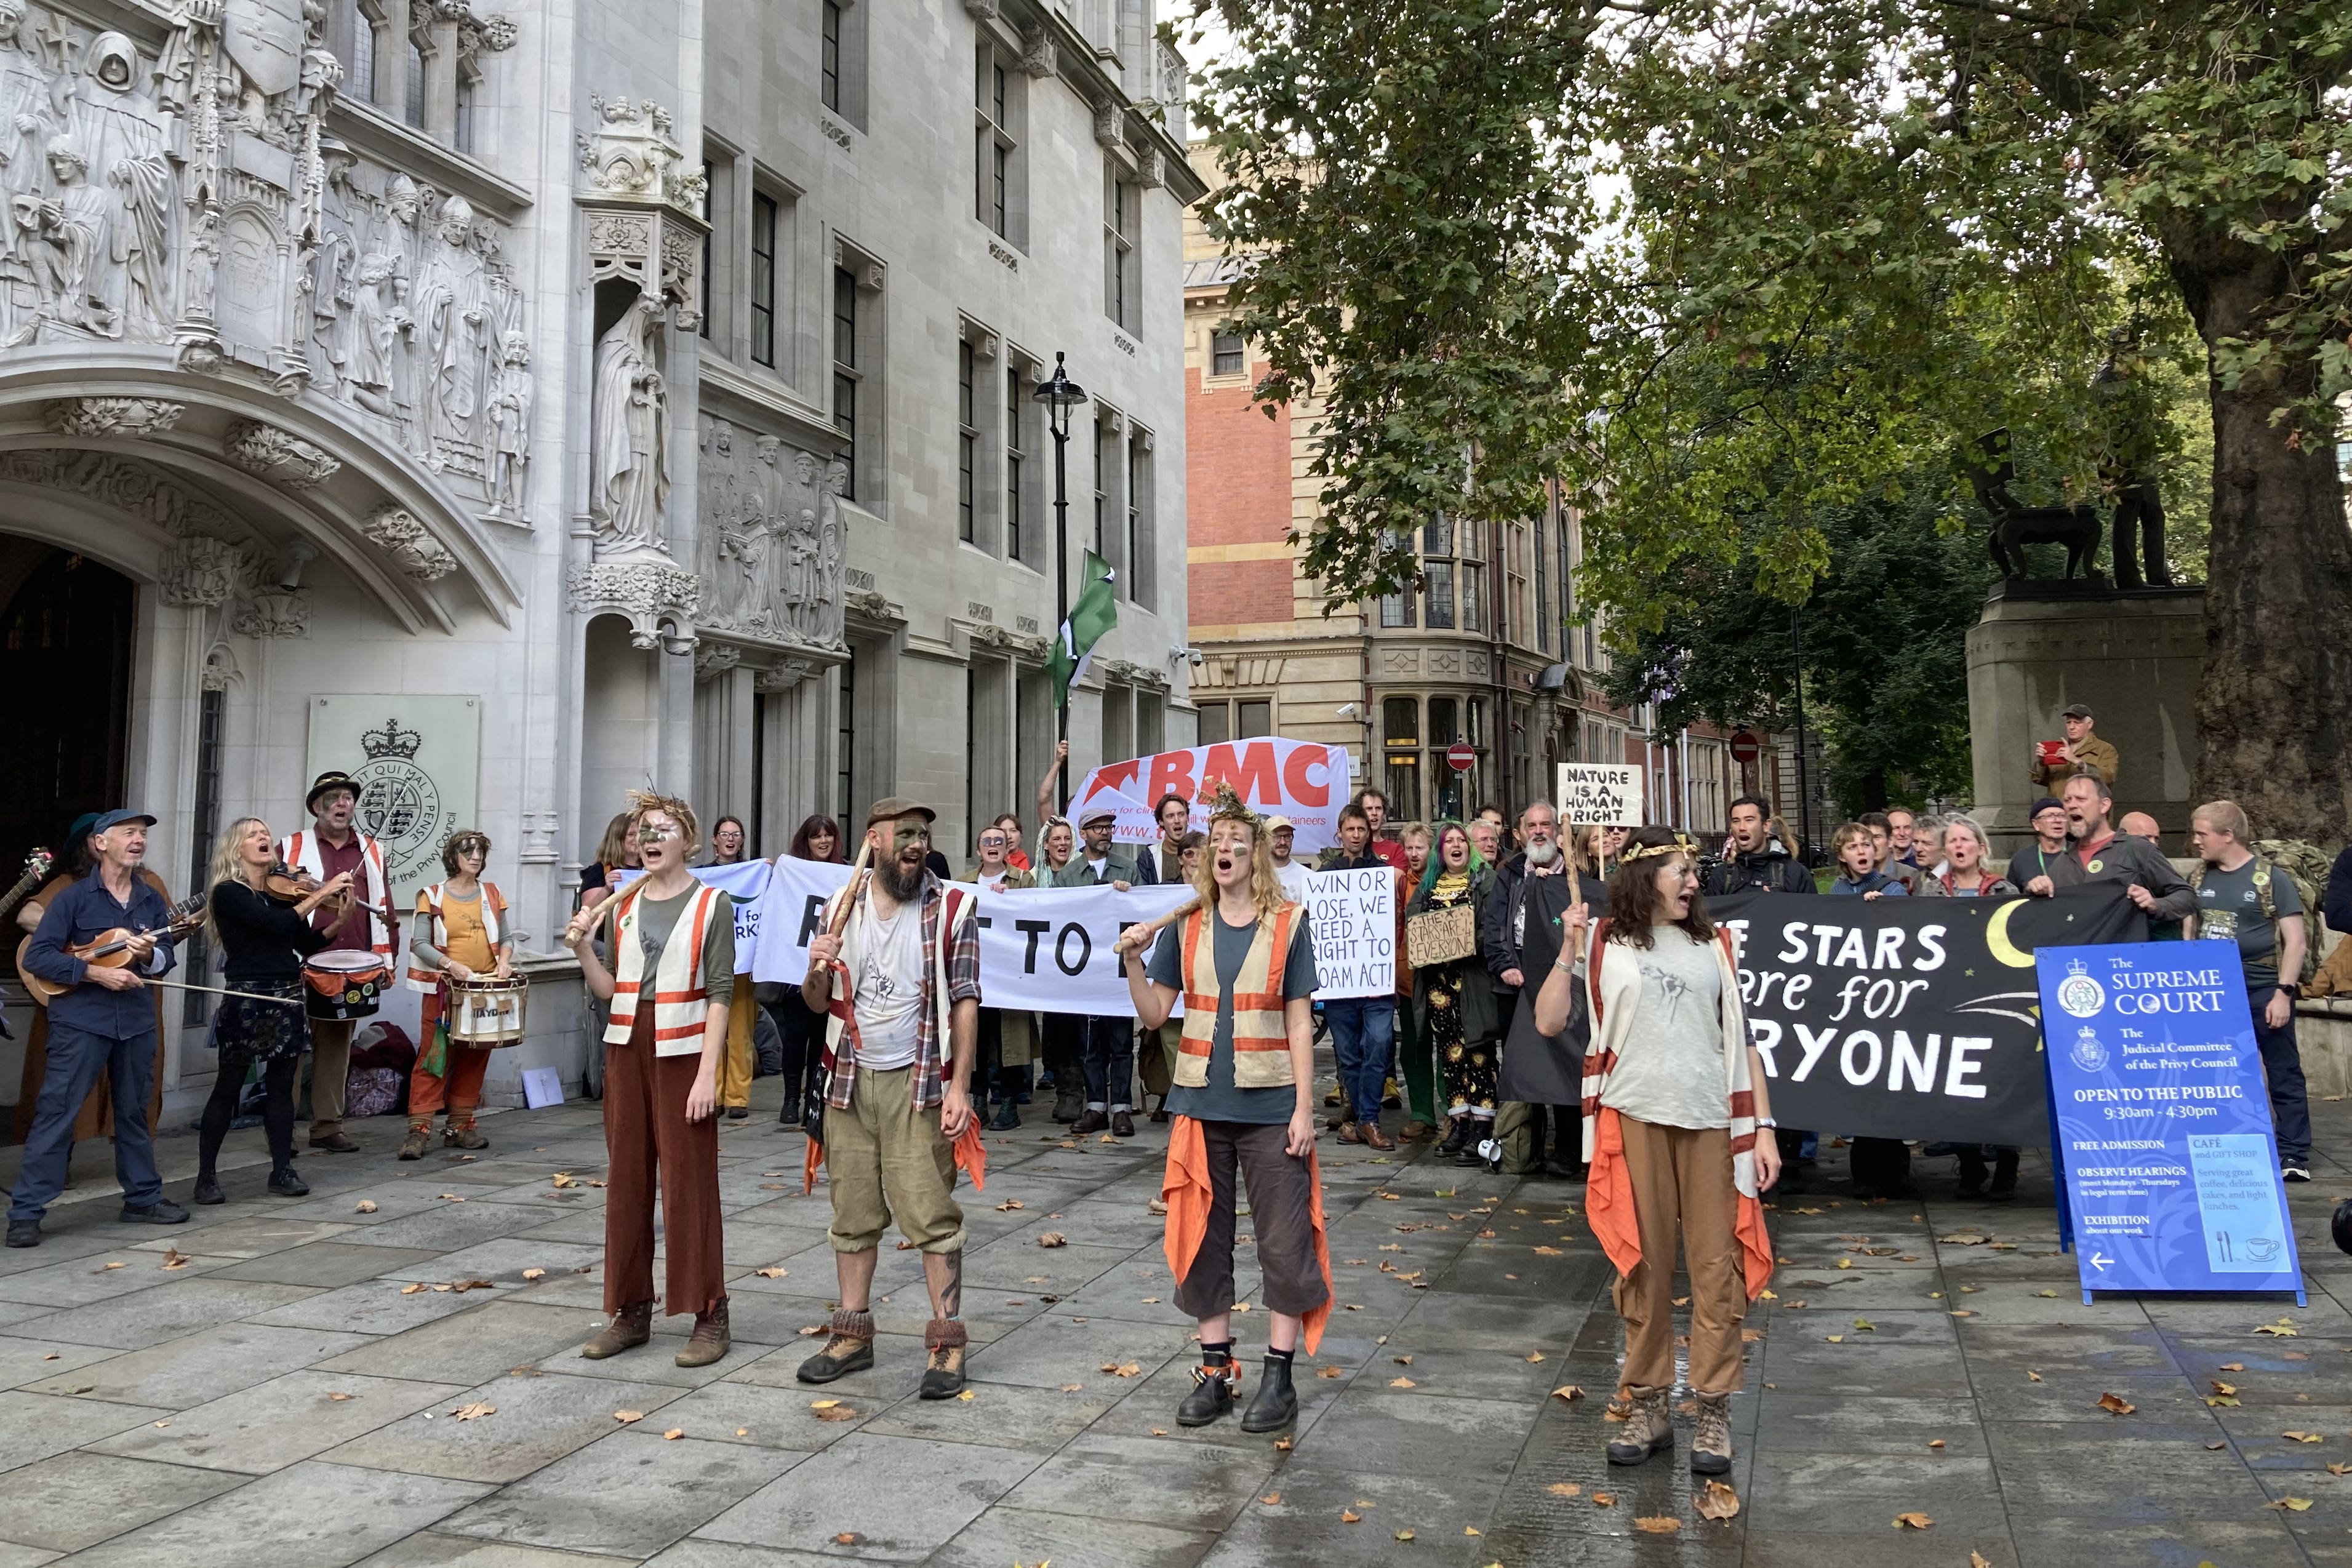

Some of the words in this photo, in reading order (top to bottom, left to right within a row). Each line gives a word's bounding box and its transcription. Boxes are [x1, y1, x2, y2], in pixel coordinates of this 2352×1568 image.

[375, 764, 401, 775] QUI
[1147, 742, 1329, 810] BMC
[357, 770, 369, 783] IT
[404, 769, 427, 791] MAL
[1567, 768, 1629, 785] NATURE
[424, 792, 434, 800] Y
[1575, 786, 1590, 798] IS
[1598, 785, 1610, 797] A
[1566, 795, 1623, 808] HUMAN
[1119, 806, 1133, 814] for
[1573, 809, 1623, 822] RIGHT
[409, 805, 435, 842] PENSE
[1288, 815, 1326, 825] taineers
[399, 870, 417, 882] the
[417, 849, 441, 873] Privy
[436, 812, 457, 848] Council
[1307, 873, 1350, 894] WIN
[1359, 871, 1386, 891] OR
[1307, 899, 1353, 920] LOSE,
[1360, 896, 1386, 914] WE
[745, 910, 761, 922] fo
[1417, 913, 1442, 926] THE
[1309, 920, 1352, 942] NEED
[1362, 918, 1375, 938] A
[1410, 924, 1440, 943] STARS
[1443, 918, 1463, 937] ARE
[1015, 919, 1091, 976] TO
[1366, 938, 1390, 958] TO
[1417, 935, 1474, 961] EVERYONE
[1777, 921, 1947, 971] STARS
[2108, 958, 2133, 969] The
[1318, 966, 1353, 988] OAM
[1360, 962, 1392, 988] ACT!
[2112, 969, 2223, 990] SUPREME
[1828, 975, 1929, 1022] for
[2115, 990, 2225, 1015] COURT
[2119, 1028, 2143, 1038] The
[2122, 1042, 2165, 1057] Judicial
[2167, 1042, 2232, 1053] Committee
[1748, 1018, 1993, 1098] RYONE
[2125, 1059, 2140, 1070] of
[2140, 1059, 2158, 1070] the
[2159, 1058, 2189, 1071] Privy
[2191, 1056, 2238, 1068] Council
[2074, 1089, 2119, 1102] OPEN
[2121, 1088, 2143, 1101] TO
[2145, 1087, 2179, 1100] THE
[2182, 1086, 2243, 1100] PUBLIC
[2104, 1106, 2154, 1120] 9:30am
[2166, 1105, 2217, 1119] 4:30pm
[2073, 1141, 2100, 1151] FREE
[2102, 1140, 2165, 1150] ADMISSION
[2193, 1137, 2222, 1148] CAFÉ
[2212, 1150, 2232, 1158] GIFT
[2077, 1167, 2127, 1177] OBSERVE
[2128, 1166, 2186, 1176] HEARINGS
[2198, 1169, 2231, 1178] Serving
[2232, 1169, 2253, 1178] great
[2079, 1180, 2101, 1188] (most
[2102, 1179, 2136, 1188] Mondays
[2140, 1178, 2180, 1187] Thursdays
[2199, 1180, 2228, 1188] coffee,
[2229, 1179, 2268, 1188] delicious
[2090, 1189, 2107, 1198] legal
[2127, 1189, 2148, 1197] time)
[2202, 1191, 2228, 1200] cakes,
[2228, 1191, 2246, 1199] and
[2247, 1191, 2268, 1201] light
[2204, 1202, 2240, 1210] lunches.
[2084, 1215, 2150, 1225] EXHIBITION
[2086, 1226, 2108, 1234] about
[2123, 1226, 2143, 1234] work
